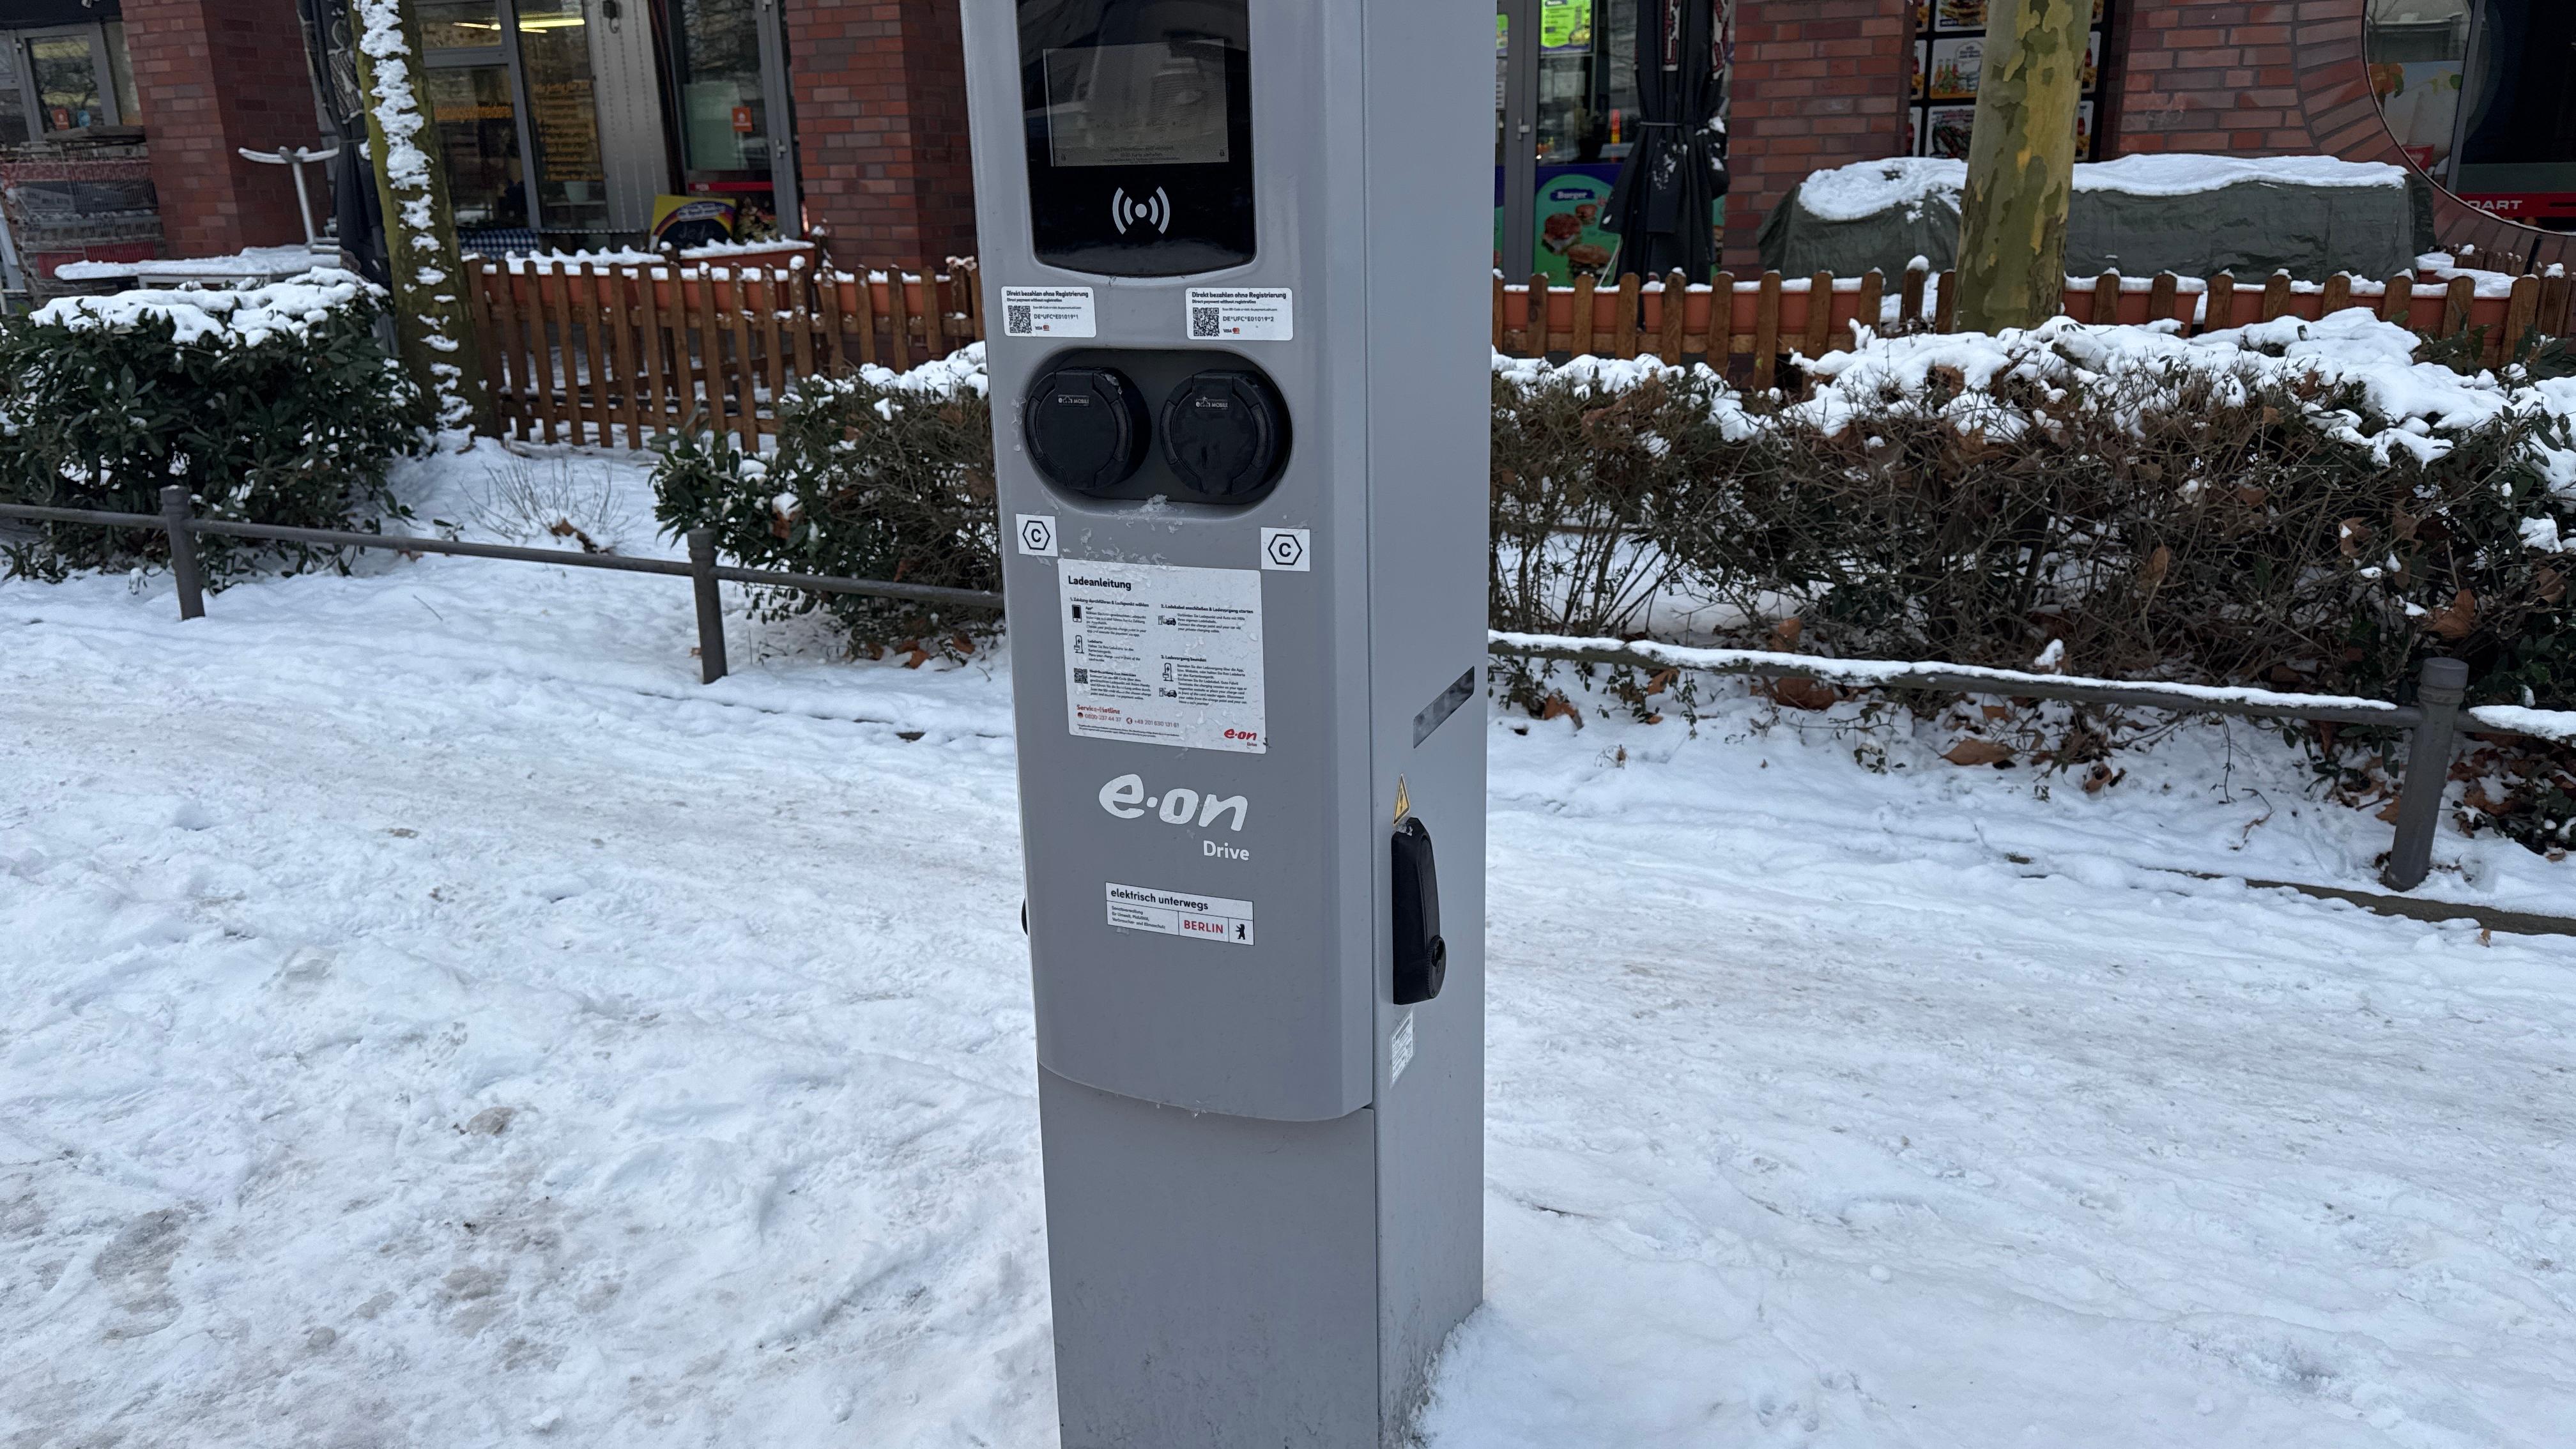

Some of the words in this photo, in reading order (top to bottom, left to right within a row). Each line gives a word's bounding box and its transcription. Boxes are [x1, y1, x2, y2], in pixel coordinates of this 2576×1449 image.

[1031, 528, 1041, 542] C
[1279, 542, 1291, 557] C
[1068, 575, 1131, 591] Ladeanleitung
[1203, 840, 1250, 861] Drive
[1110, 888, 1156, 902] elektrisch
[1158, 896, 1209, 911] unterwegs
[1184, 919, 1223, 933] BERLIN
